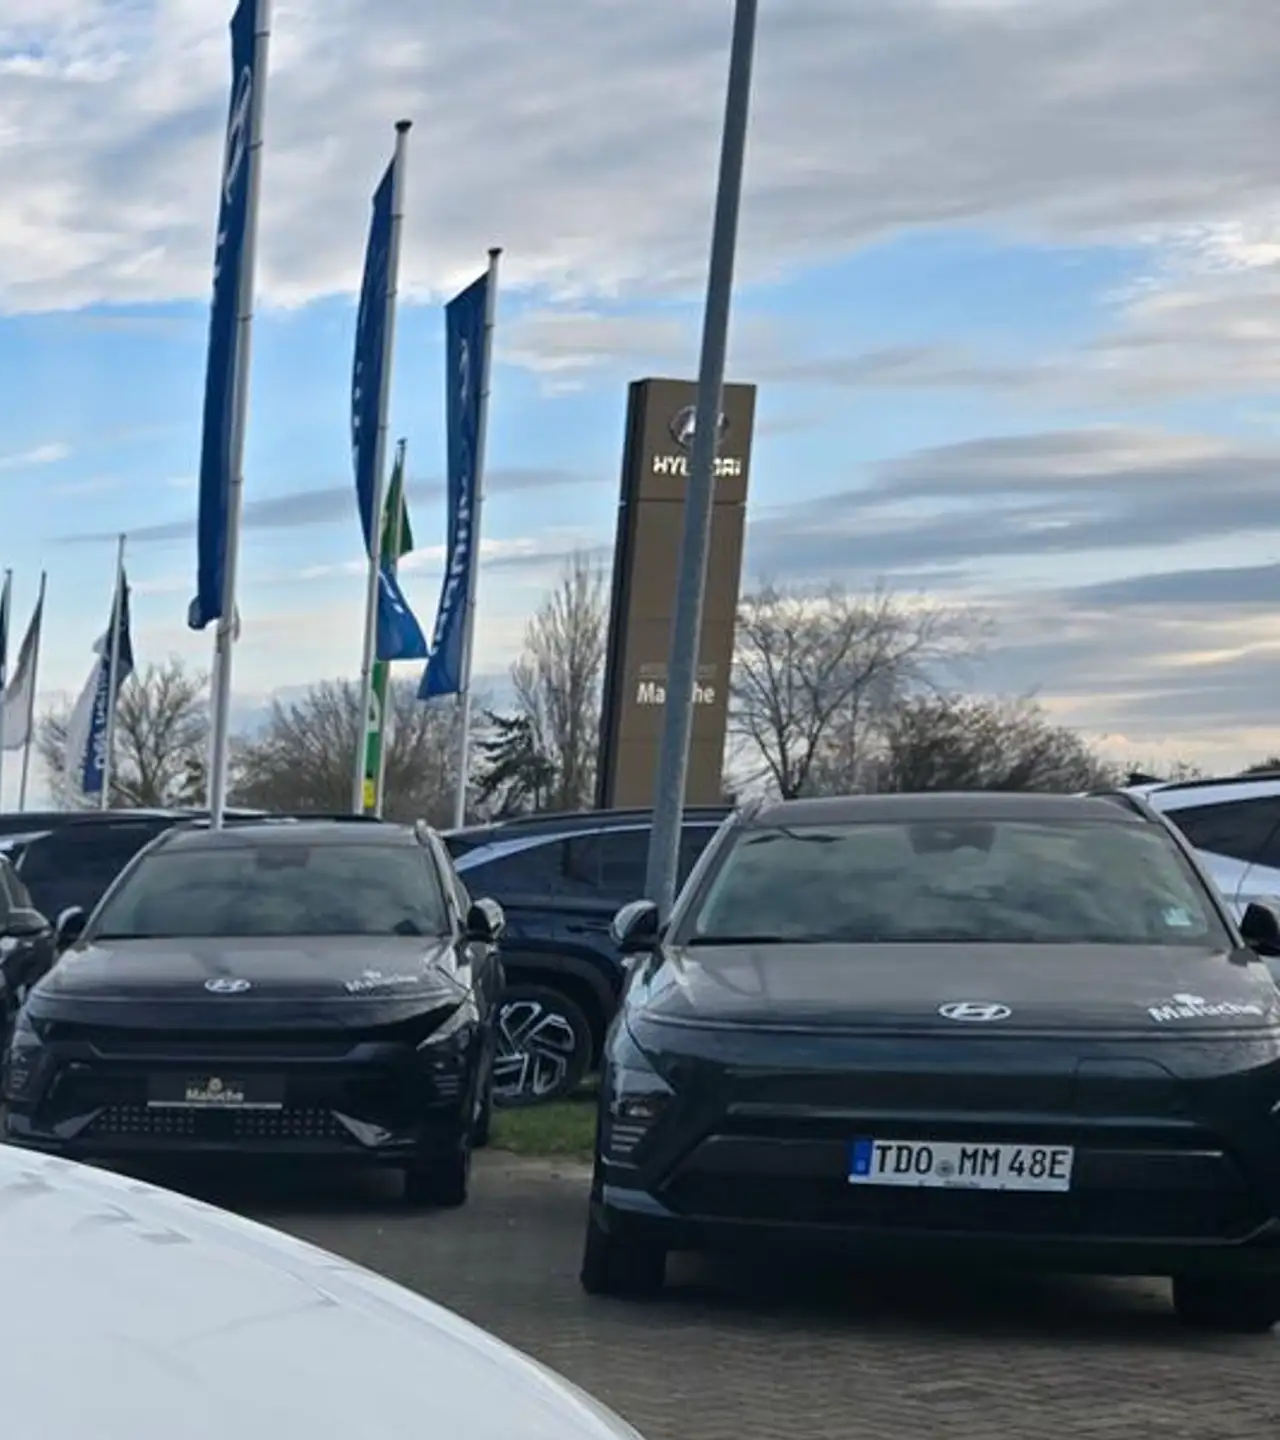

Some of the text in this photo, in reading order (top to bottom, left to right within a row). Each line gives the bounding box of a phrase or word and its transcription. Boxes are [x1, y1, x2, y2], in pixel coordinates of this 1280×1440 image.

[652, 455, 741, 477] HYDAI
[636, 681, 716, 705] Mahe
[875, 1144, 1070, 1179] TDO MM 48E
